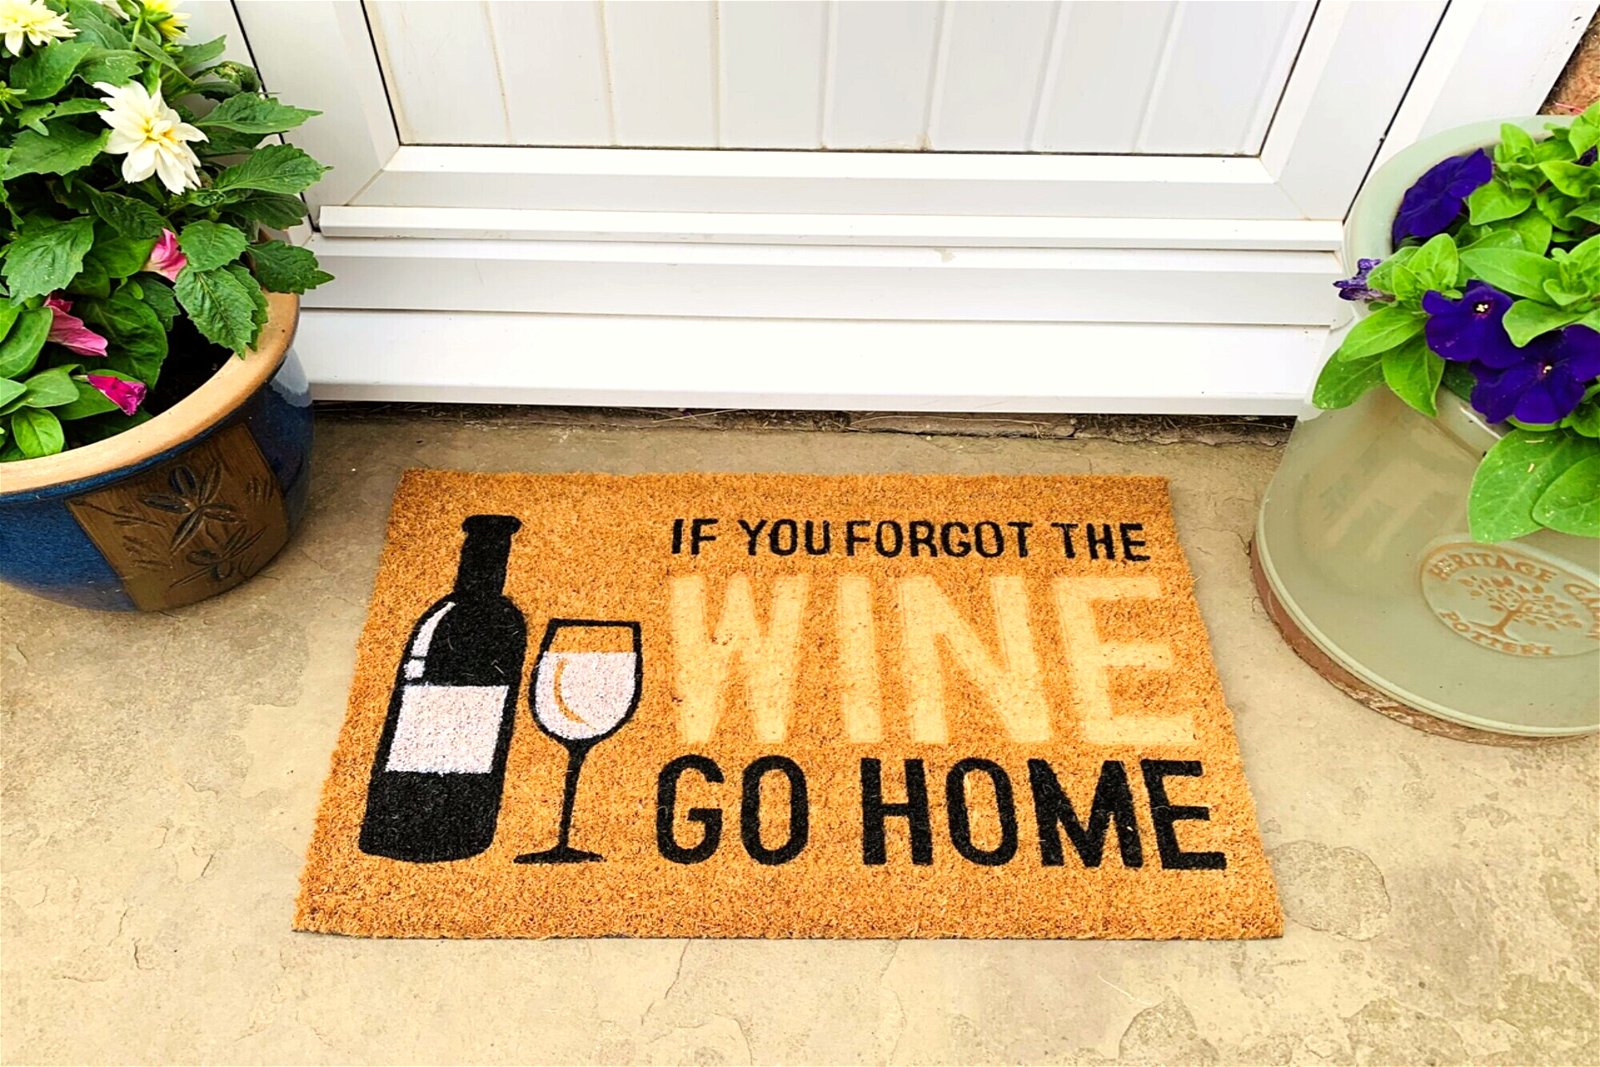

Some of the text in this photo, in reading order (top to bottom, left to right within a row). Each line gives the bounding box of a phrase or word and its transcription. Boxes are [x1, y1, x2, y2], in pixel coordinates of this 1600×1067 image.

[671, 518, 1151, 562] IF YOU FORGOT THE
[1428, 552, 1557, 582] HERITAGE
[669, 574, 1196, 745] WINE
[655, 753, 1227, 871] GO HOME
